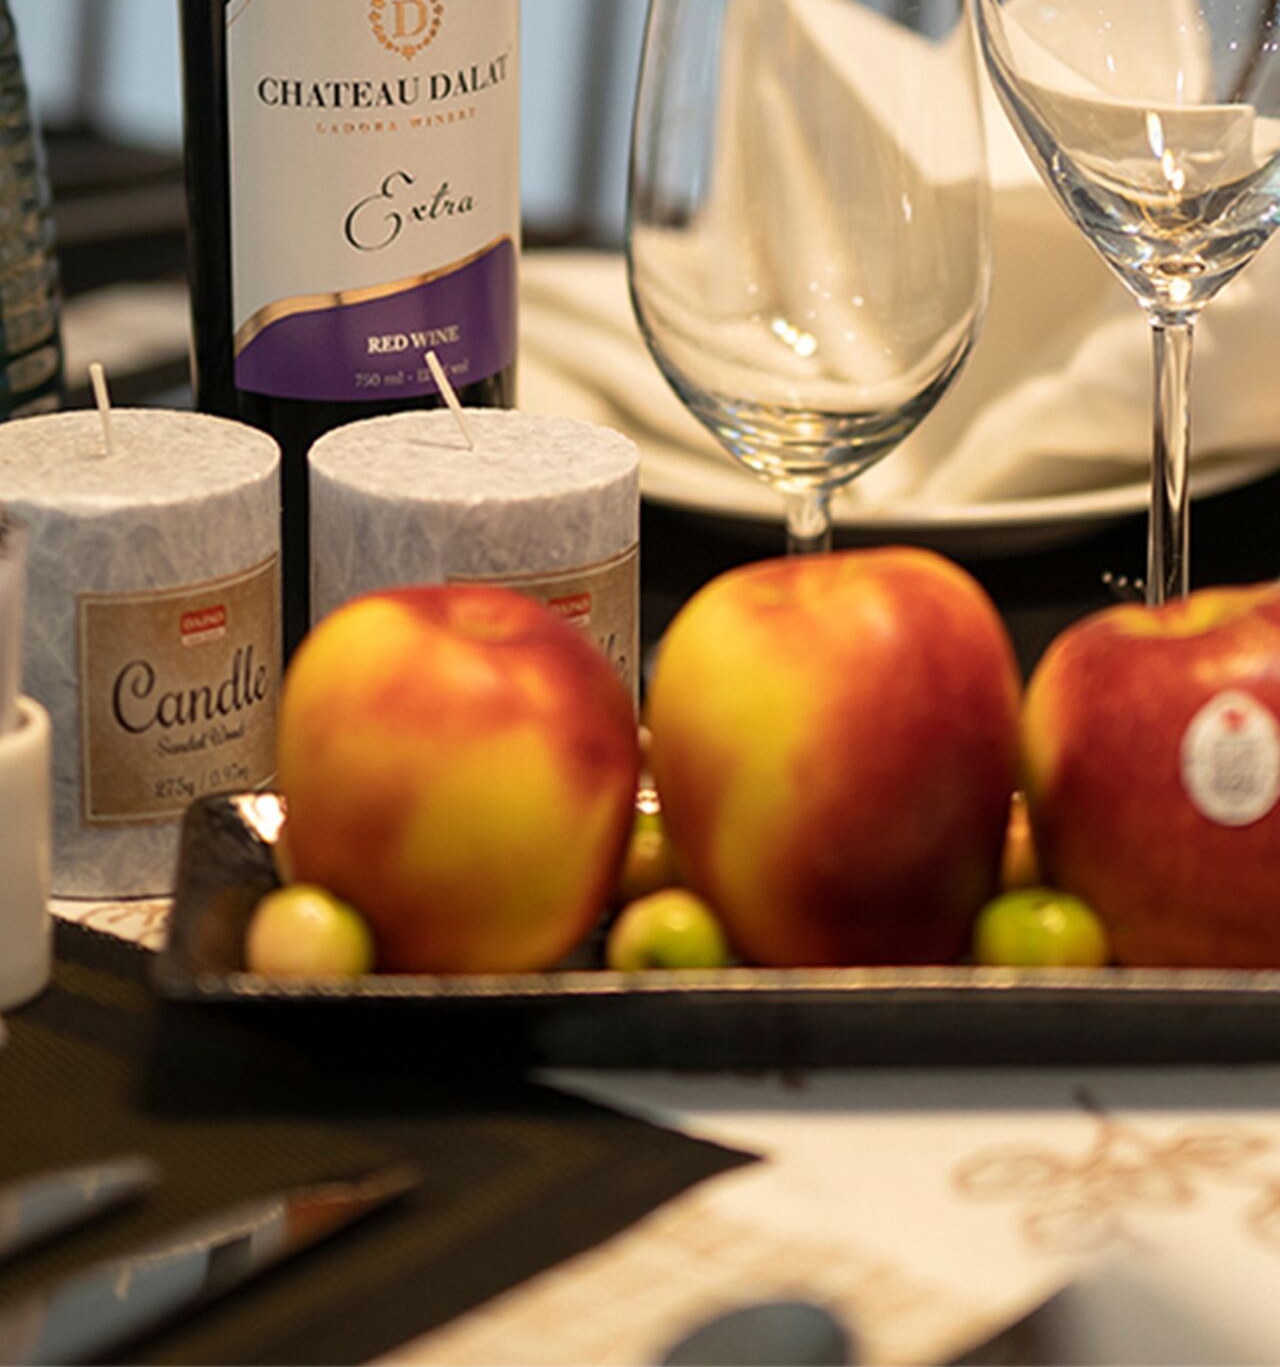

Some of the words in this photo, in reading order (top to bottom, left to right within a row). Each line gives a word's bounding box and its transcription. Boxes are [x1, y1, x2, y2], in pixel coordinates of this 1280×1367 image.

[257, 77, 420, 109] CHATEAU
[429, 54, 508, 100] DALAT
[316, 121, 398, 134] LADORA
[344, 171, 474, 252] Extra
[367, 334, 409, 354] RED
[410, 324, 459, 349] WINE
[355, 373, 382, 389] 750
[383, 370, 405, 387] ml
[113, 645, 267, 734] Candle
